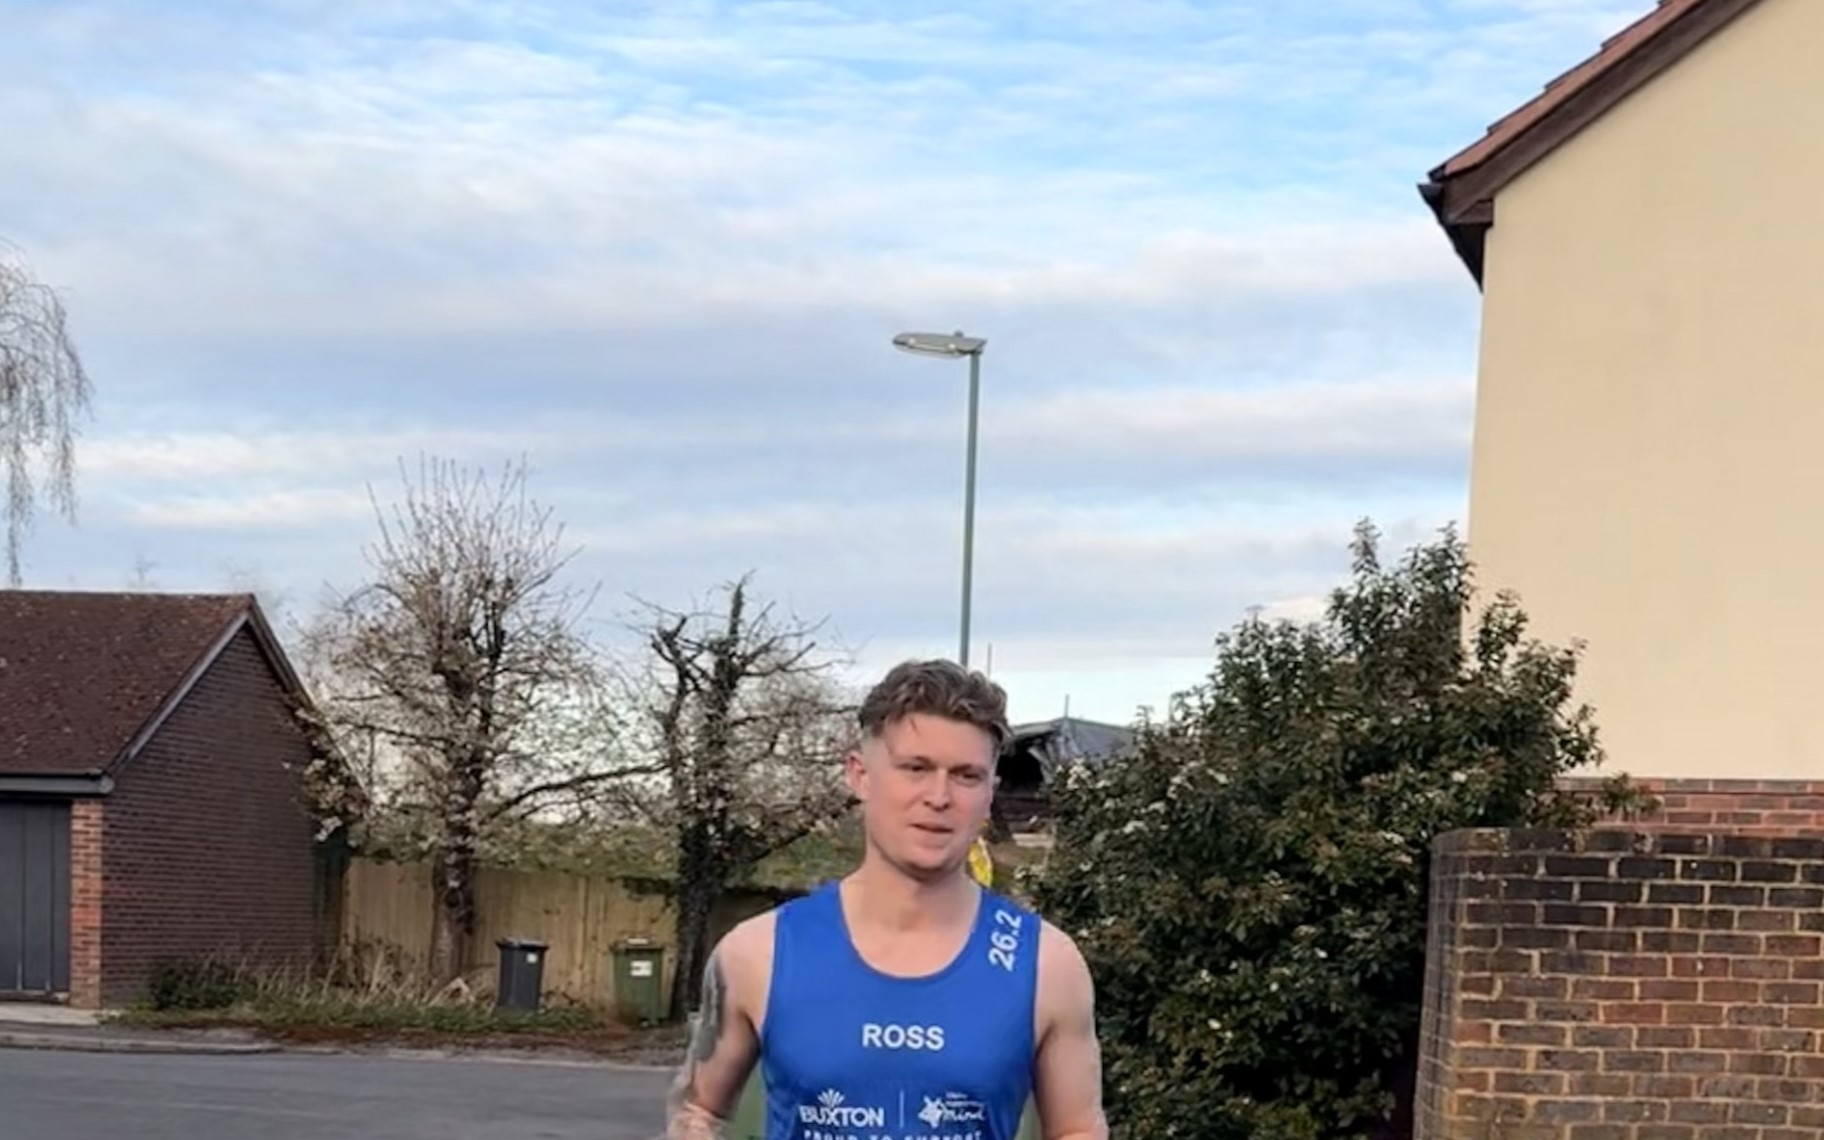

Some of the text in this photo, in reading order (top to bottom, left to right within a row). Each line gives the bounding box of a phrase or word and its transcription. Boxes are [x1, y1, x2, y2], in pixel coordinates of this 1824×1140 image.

[988, 908, 1022, 972] 26.2
[862, 1023, 945, 1051] ROSS
[799, 1105, 885, 1127] BUXTON
